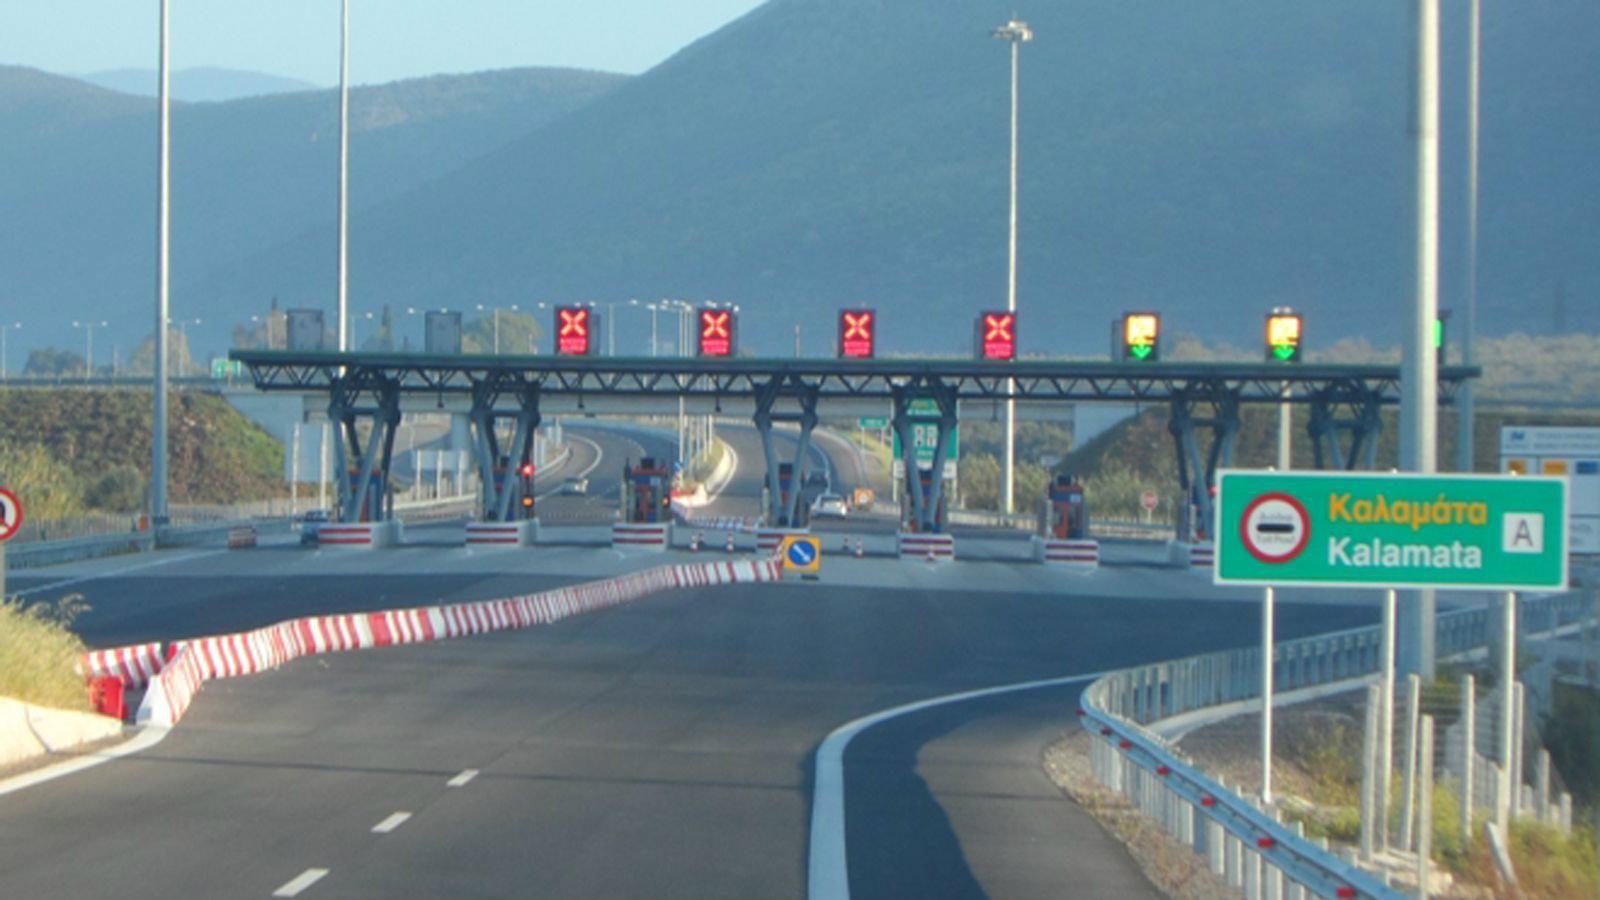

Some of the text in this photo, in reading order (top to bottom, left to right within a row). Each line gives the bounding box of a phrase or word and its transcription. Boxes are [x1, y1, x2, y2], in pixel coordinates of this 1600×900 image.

[1329, 493, 1487, 530] Καλαμάτα
[1512, 518, 1534, 548] A
[1328, 536, 1482, 568] Kalamata
